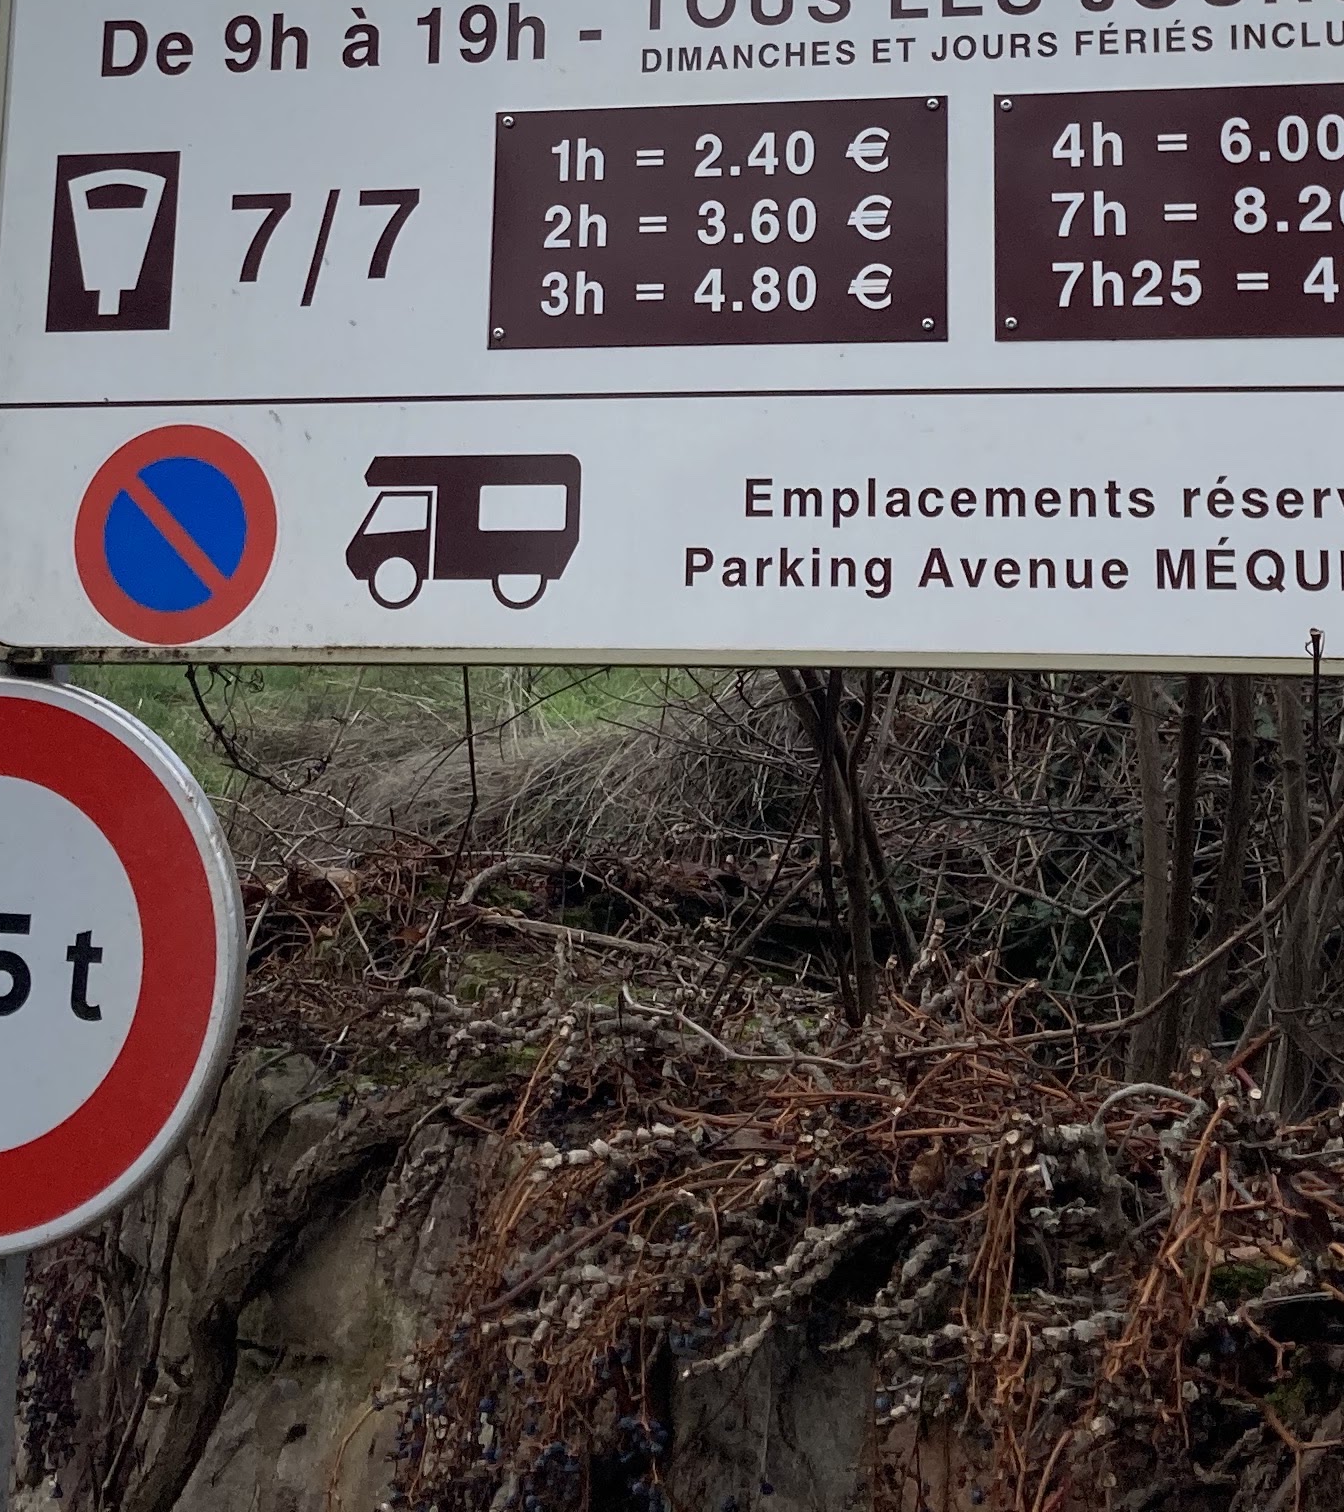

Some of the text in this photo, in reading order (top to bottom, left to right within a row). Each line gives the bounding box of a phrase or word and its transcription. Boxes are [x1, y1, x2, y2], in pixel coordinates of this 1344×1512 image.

[101, 20, 193, 77] De
[225, 13, 308, 72] 9h
[343, 8, 379, 68] à
[417, 3, 545, 64] 19h
[642, 40, 855, 72] DIMANCHES
[873, 38, 915, 63] ET
[932, 32, 1057, 61] JOURS
[1076, 26, 1212, 55] FÉRIÉS
[552, 127, 889, 181] 1h = 2.40 €
[1053, 122, 1122, 166] 4h
[1158, 134, 1187, 151] =
[544, 195, 892, 248] 2h = 3.60 €
[1052, 191, 1126, 236] 7h
[1164, 204, 1197, 220] =
[232, 189, 420, 306] 7/7
[541, 264, 892, 315] 3h = 4.80 €
[1052, 260, 1201, 307] 7h25
[1237, 273, 1268, 290] =
[746, 478, 1155, 528] Emplacements
[686, 548, 891, 598] Parking
[918, 548, 1128, 589] Avenue
[66, 931, 103, 1021] t
